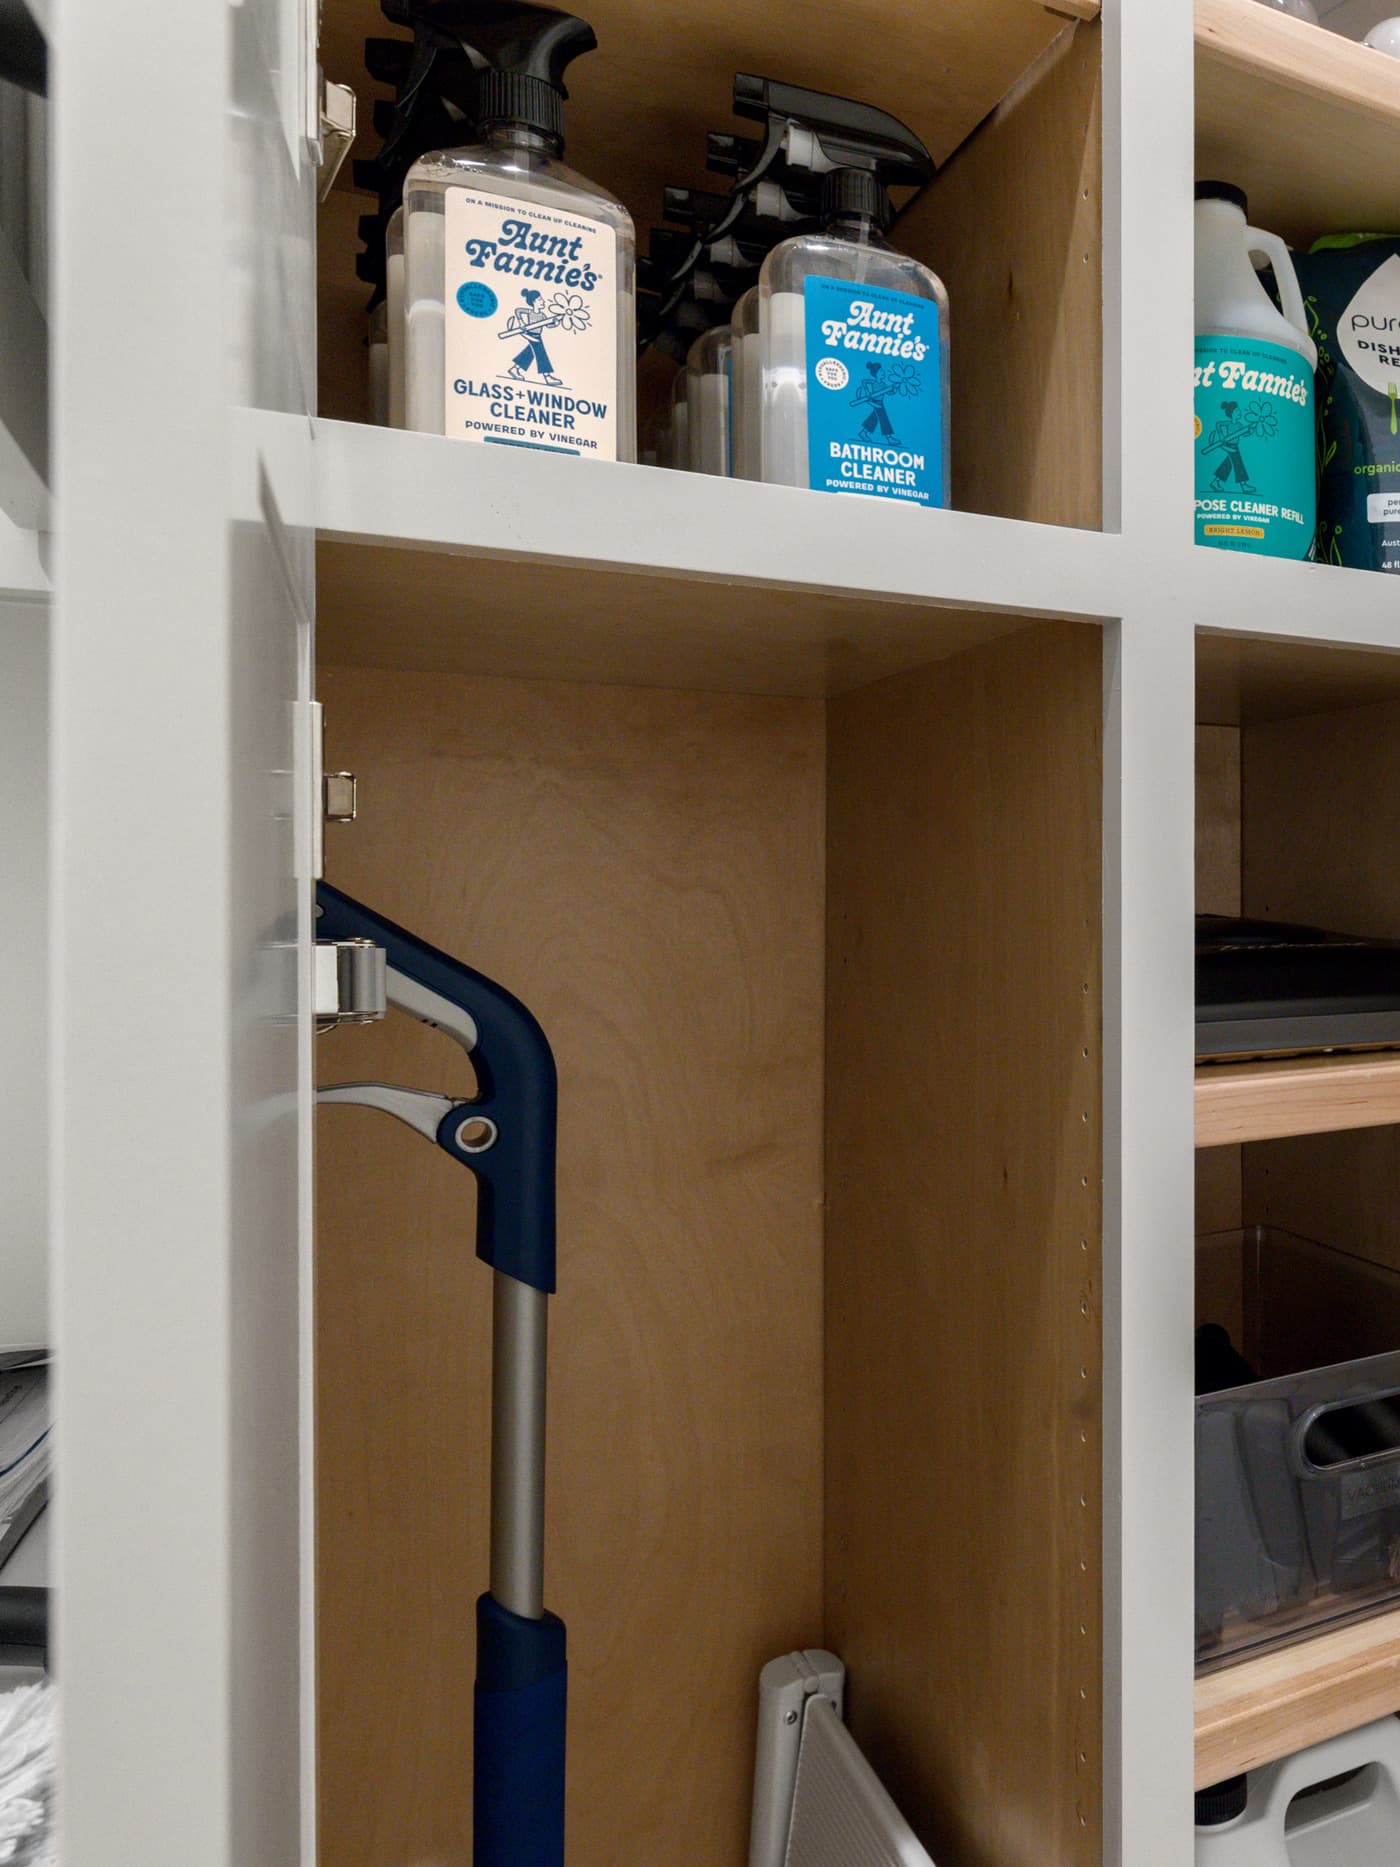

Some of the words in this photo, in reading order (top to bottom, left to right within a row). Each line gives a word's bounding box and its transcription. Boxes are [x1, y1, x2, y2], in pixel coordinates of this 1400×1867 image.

[484, 202, 515, 213] MISSION
[528, 211, 552, 221] CLEAN
[564, 220, 597, 234] CLEANING
[498, 219, 583, 261] Aunt
[465, 239, 598, 291] Fannie's
[846, 300, 915, 335] Aunt
[821, 319, 926, 361] Fannie's
[1357, 339, 1400, 356] DISH
[1218, 360, 1307, 407] Fannie's
[490, 402, 576, 430] CLEANER
[465, 420, 526, 436] POWERED
[530, 429, 545, 439] BY
[549, 433, 598, 449] VINEGAR
[829, 441, 925, 471] BATHROOM
[840, 461, 916, 487] CLEANER
[826, 479, 874, 492] POWERED
[877, 484, 889, 493] BY
[892, 487, 929, 500] VINEGAR
[1230, 500, 1279, 517] CLEANER
[1281, 507, 1305, 525] REFILL
[1381, 561, 1393, 569] 48
